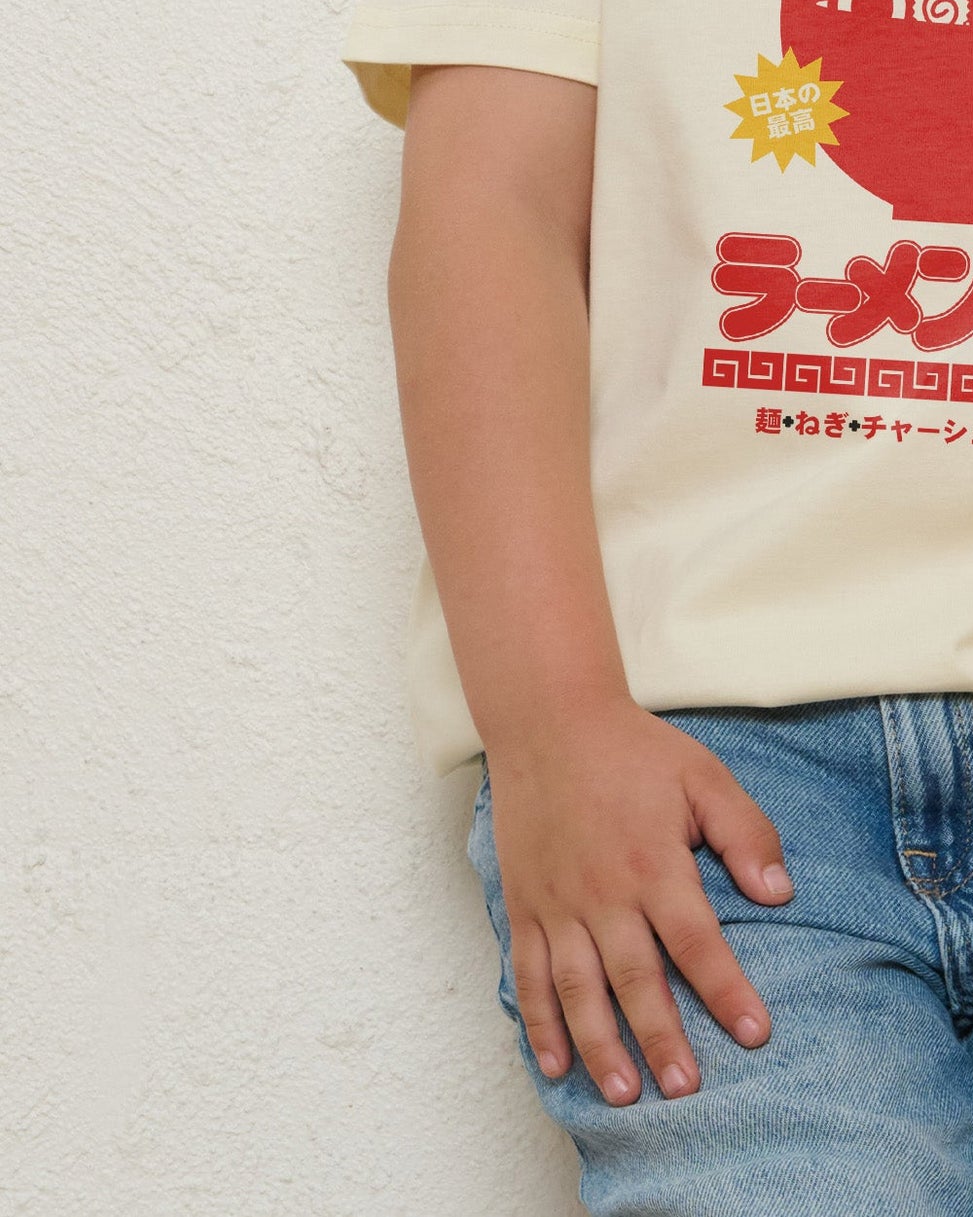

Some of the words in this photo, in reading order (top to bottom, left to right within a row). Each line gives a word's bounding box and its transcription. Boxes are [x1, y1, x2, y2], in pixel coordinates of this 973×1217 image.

[749, 82, 821, 117] 日本の
[767, 108, 815, 139] 最高
